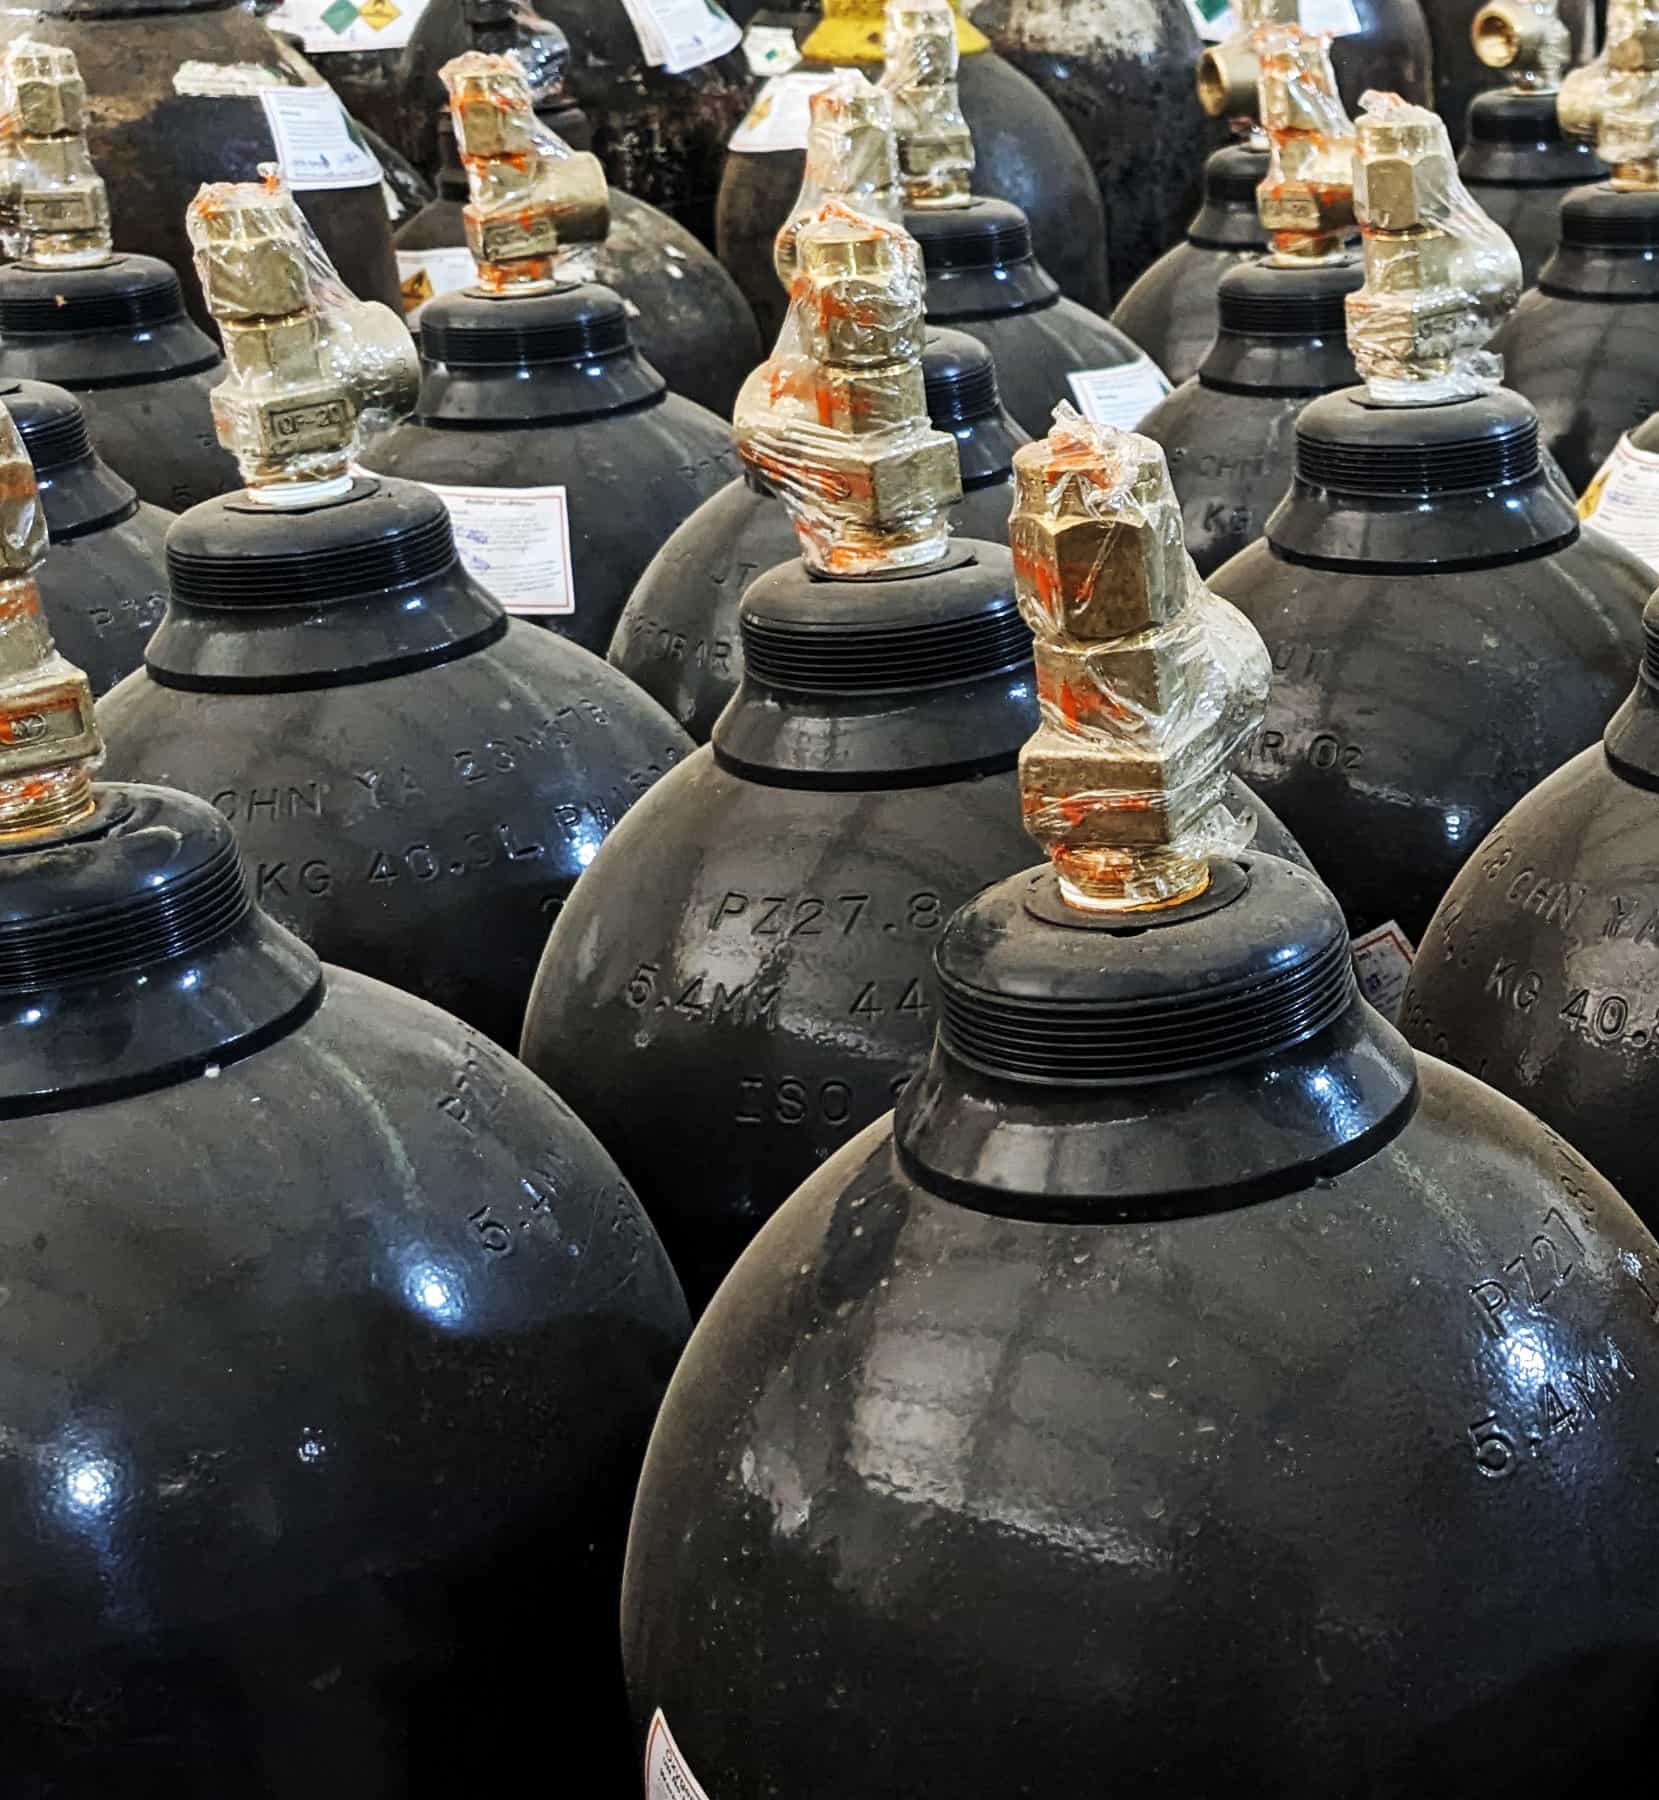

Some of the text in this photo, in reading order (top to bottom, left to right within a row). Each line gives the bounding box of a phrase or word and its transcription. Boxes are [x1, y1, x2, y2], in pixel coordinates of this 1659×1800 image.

[256, 857, 334, 902] KG
[708, 889, 943, 937] PZ27.8
[735, 1076, 852, 1126] ISO
